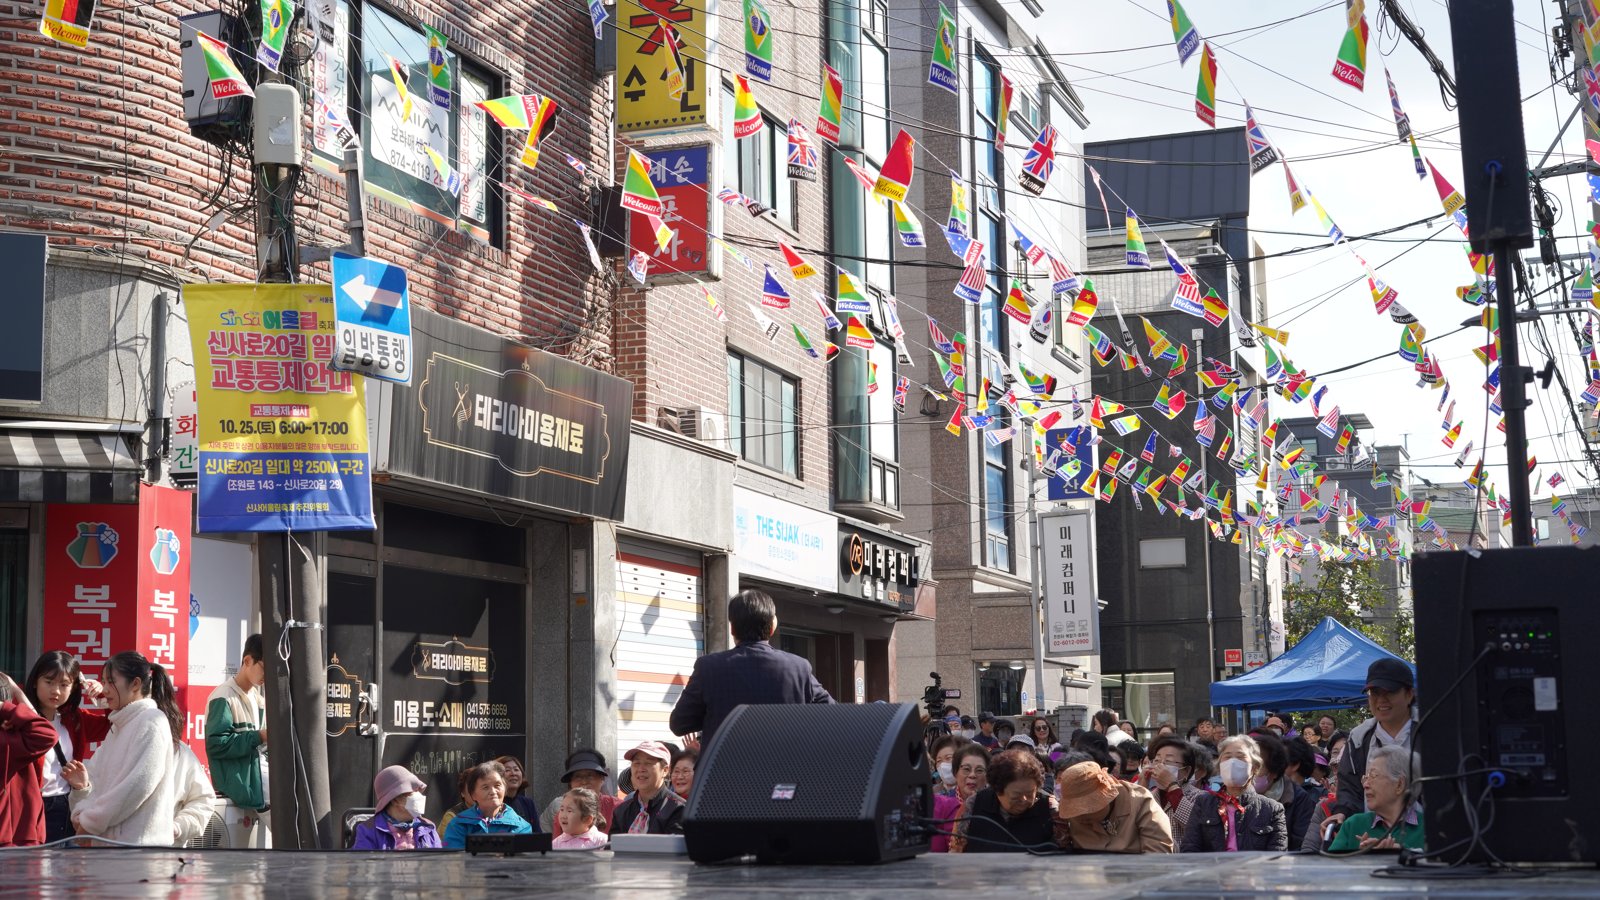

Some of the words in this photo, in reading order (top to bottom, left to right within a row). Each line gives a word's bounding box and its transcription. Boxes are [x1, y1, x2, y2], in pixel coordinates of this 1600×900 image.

[43, 20, 87, 44] Welcome
[746, 55, 771, 79] Welcome
[734, 115, 764, 134] Welcome
[390, 149, 431, 181] 874-4119
[789, 166, 817, 180] Welcome
[876, 180, 904, 198] Welcome
[623, 195, 661, 213] Welcome
[838, 302, 871, 312] Welcome
[1005, 305, 1030, 323] Welcome
[1174, 299, 1204, 315] Welcome
[208, 331, 308, 358] 신사로20길
[342, 328, 406, 374] 일방통행
[847, 338, 875, 348] Welcome
[211, 359, 353, 393] 교통통제안내
[253, 405, 290, 416] 교통통제
[475, 393, 584, 454] 테리아미용재료
[205, 458, 263, 475] 신사로20길
[266, 459, 291, 475] 일대
[293, 459, 303, 475] 약
[305, 460, 338, 475] 250M
[340, 460, 364, 475] 구간
[227, 479, 255, 491] (조원로
[258, 480, 274, 490] 143
[284, 479, 327, 490] 신사로20길
[756, 514, 774, 538] THE
[776, 520, 799, 545] SIJAK
[864, 541, 918, 586] 미래컴퍼니
[1060, 525, 1076, 615] 미래컴퍼니
[432, 653, 487, 673] 테리아미용재료
[327, 683, 351, 699] 테리아
[394, 700, 419, 728] 미용
[466, 702, 478, 715] 041
[479, 703, 490, 715] 575
[466, 717, 478, 729] 010
